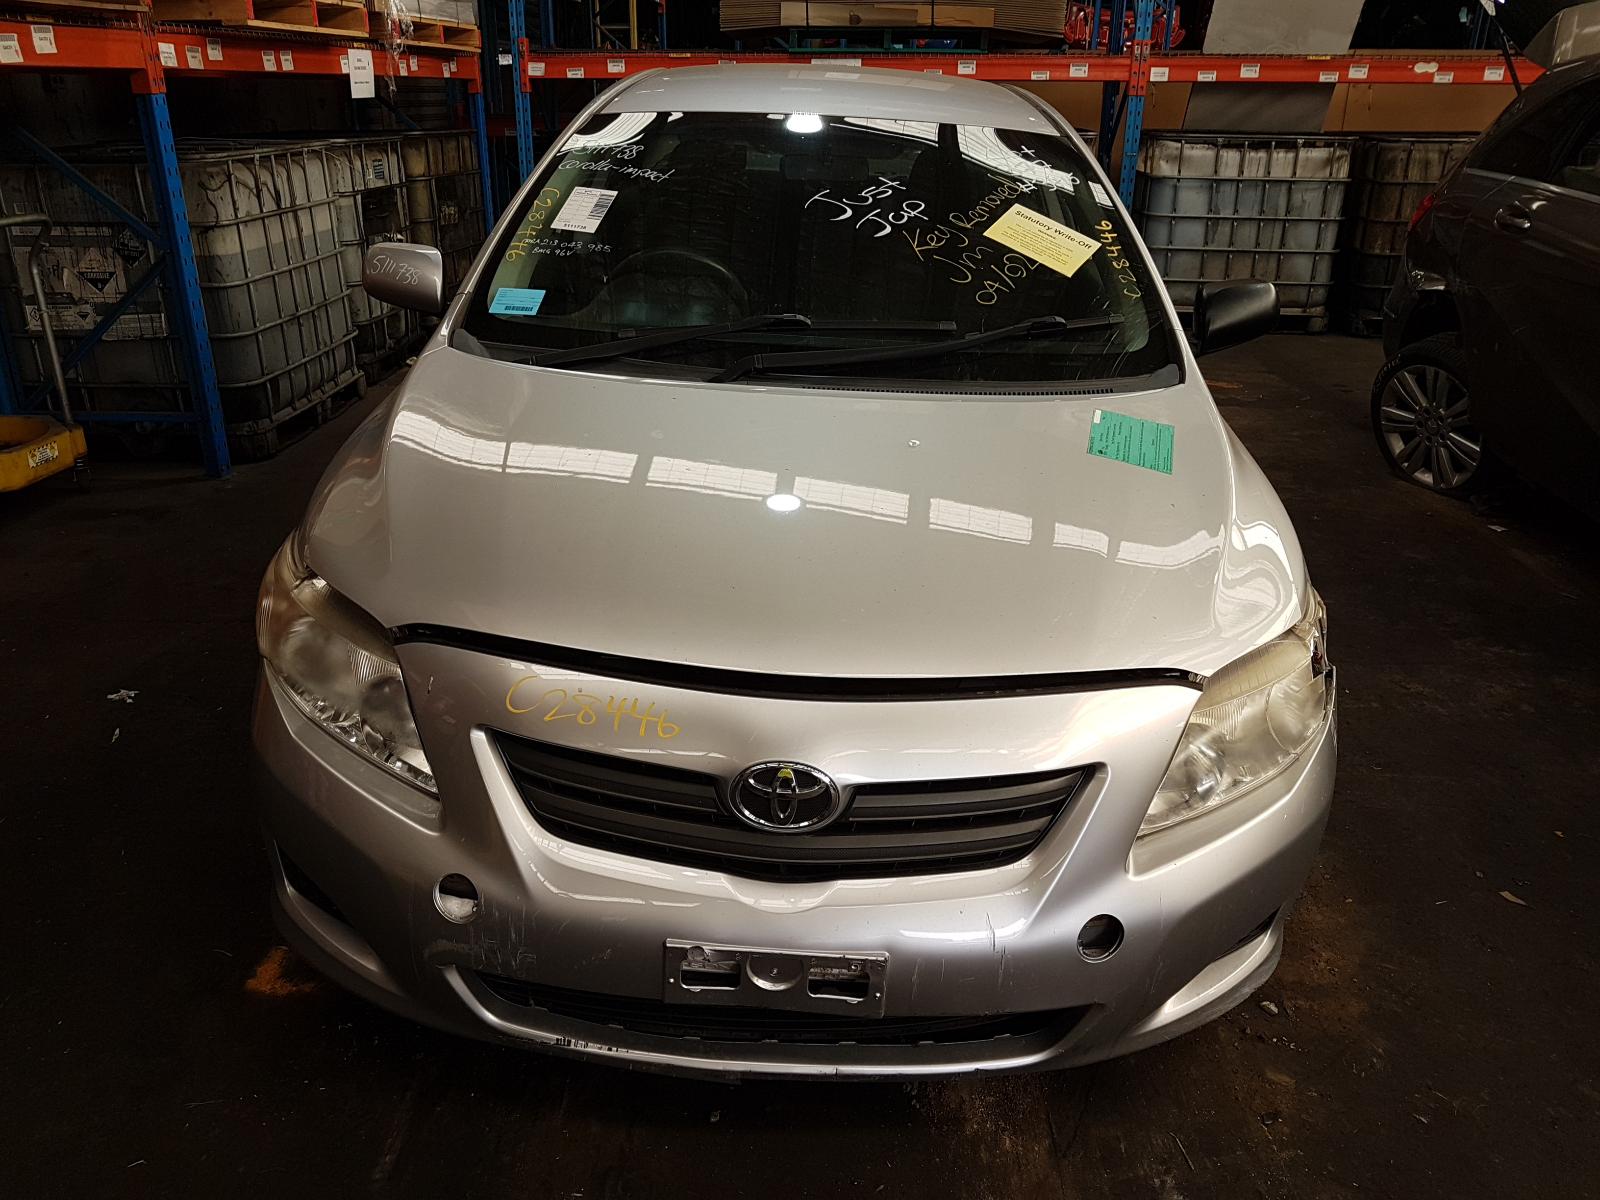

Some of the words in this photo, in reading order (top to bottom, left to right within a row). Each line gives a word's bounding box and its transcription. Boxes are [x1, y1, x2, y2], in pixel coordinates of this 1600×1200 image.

[902, 224, 969, 262] Key
[949, 173, 1026, 230] Removed
[1014, 210, 1053, 231] Statutory
[1054, 228, 1092, 250] Write-Off
[505, 675, 683, 739] C28446
